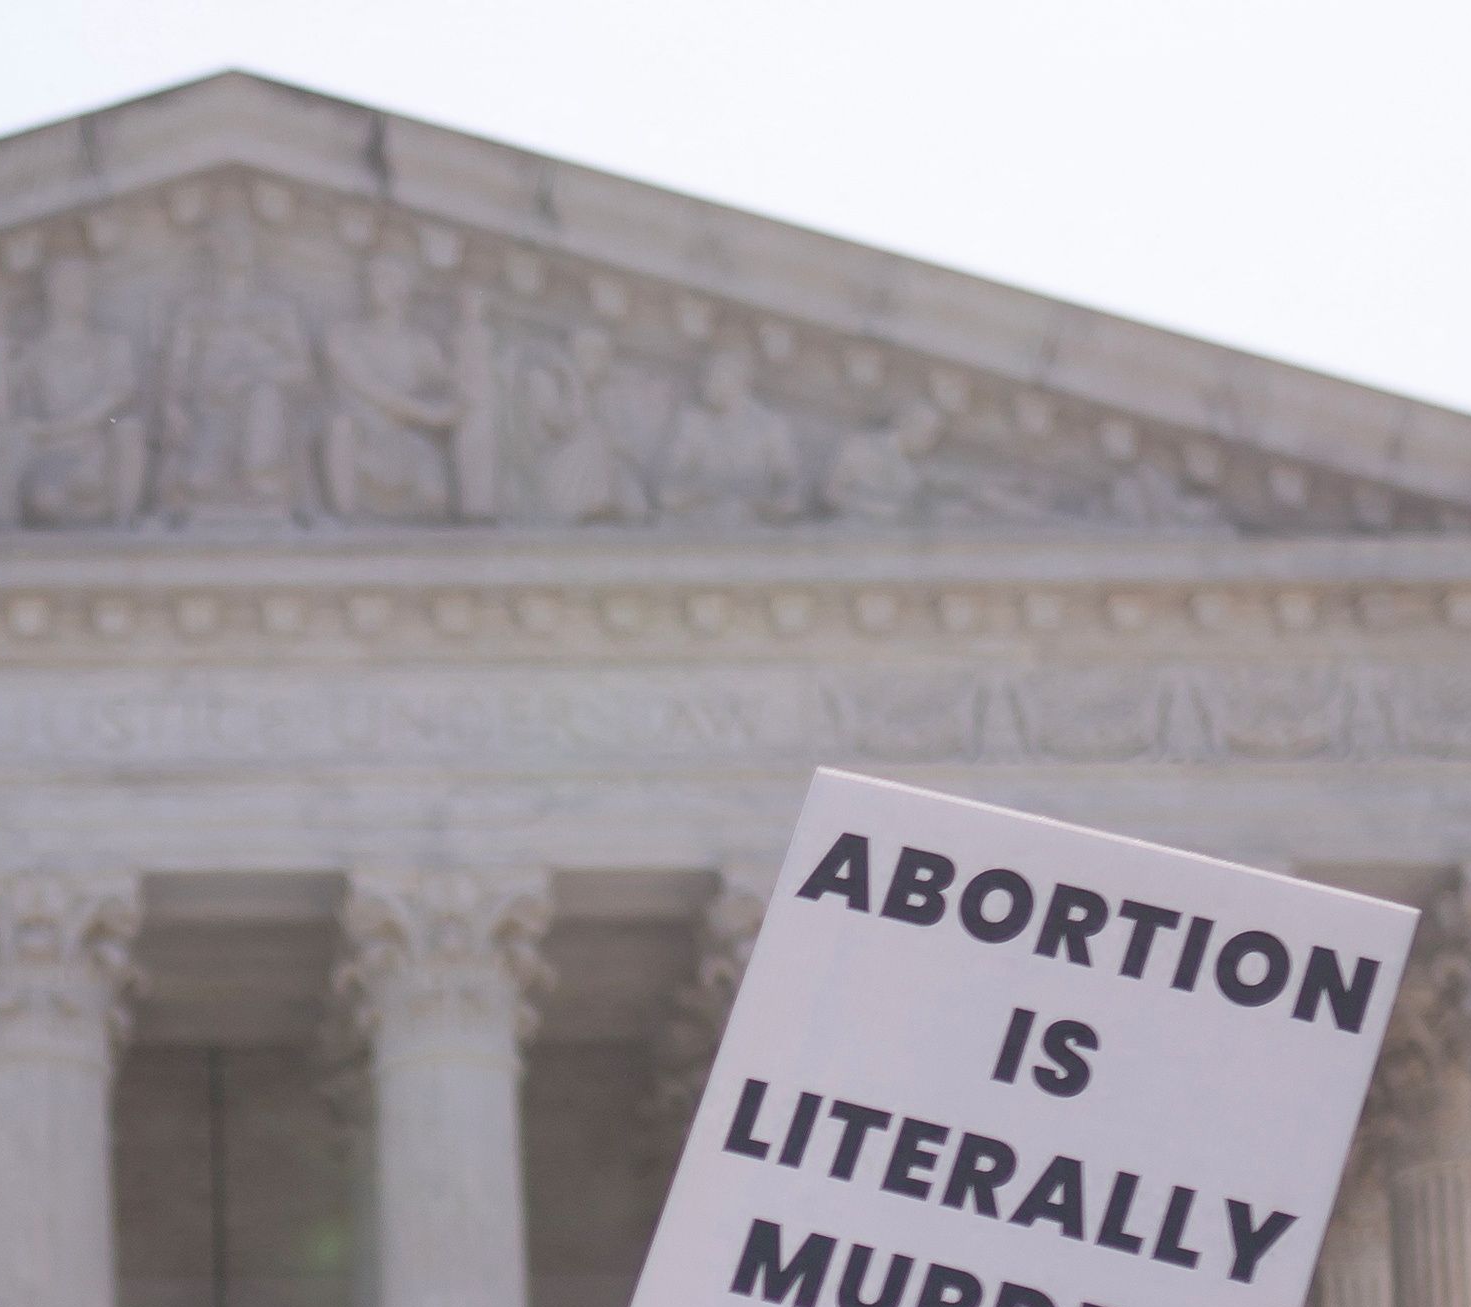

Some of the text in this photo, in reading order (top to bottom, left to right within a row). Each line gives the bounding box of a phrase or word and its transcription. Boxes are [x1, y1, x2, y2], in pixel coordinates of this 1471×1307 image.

[796, 832, 1381, 1035] ABORTION
[990, 1006, 1101, 1098] IS
[722, 1078, 1300, 1286] LITERALLY
